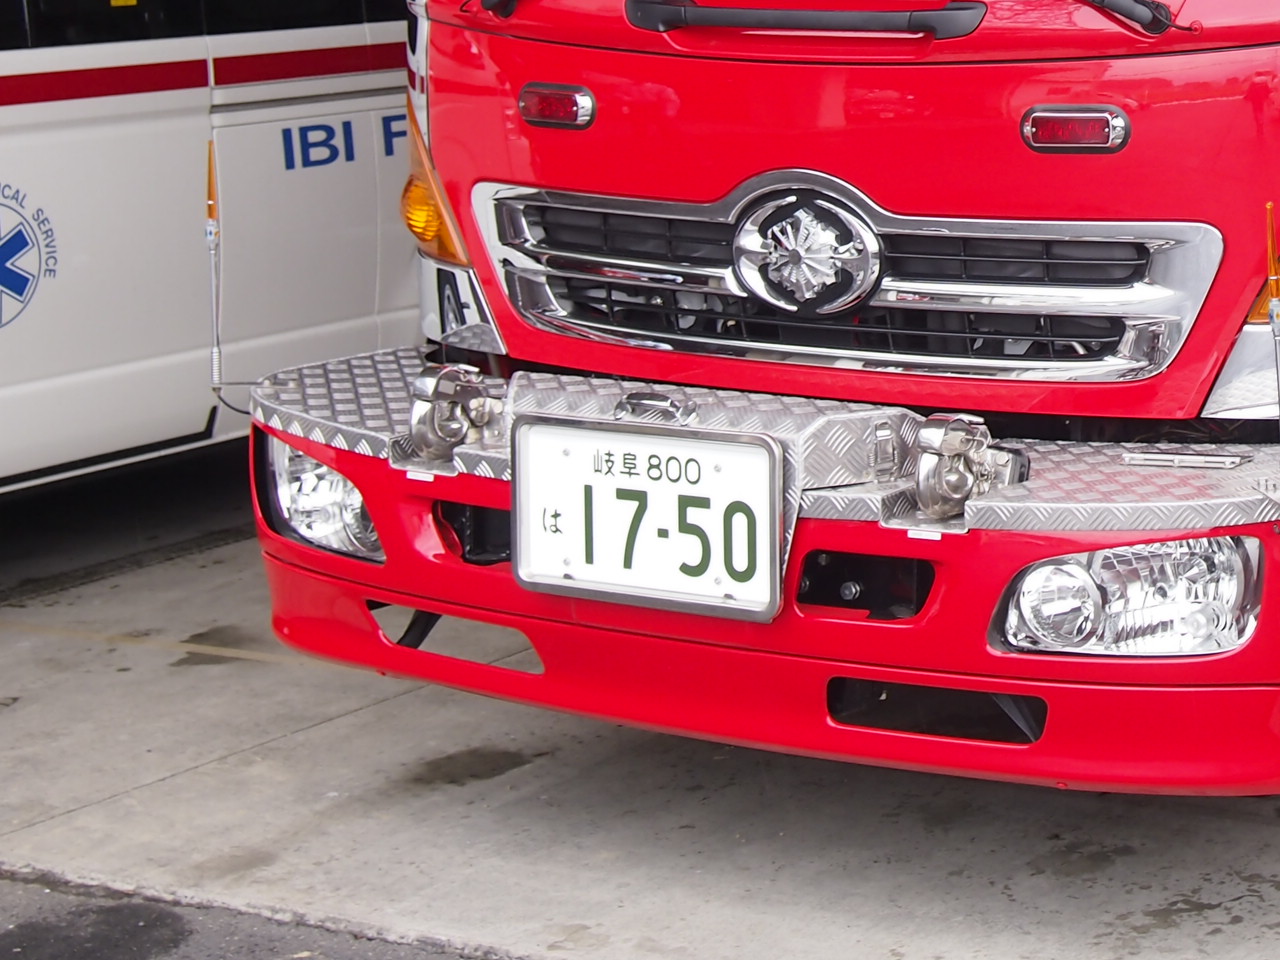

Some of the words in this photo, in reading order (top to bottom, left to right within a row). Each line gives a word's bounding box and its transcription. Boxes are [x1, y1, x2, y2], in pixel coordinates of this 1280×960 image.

[281, 120, 355, 171] IBI
[31, 207, 58, 280] SERVICE
[593, 449, 641, 479] 岐阜
[646, 453, 702, 486] 800
[542, 507, 564, 535] は
[583, 484, 758, 584] 17-50
